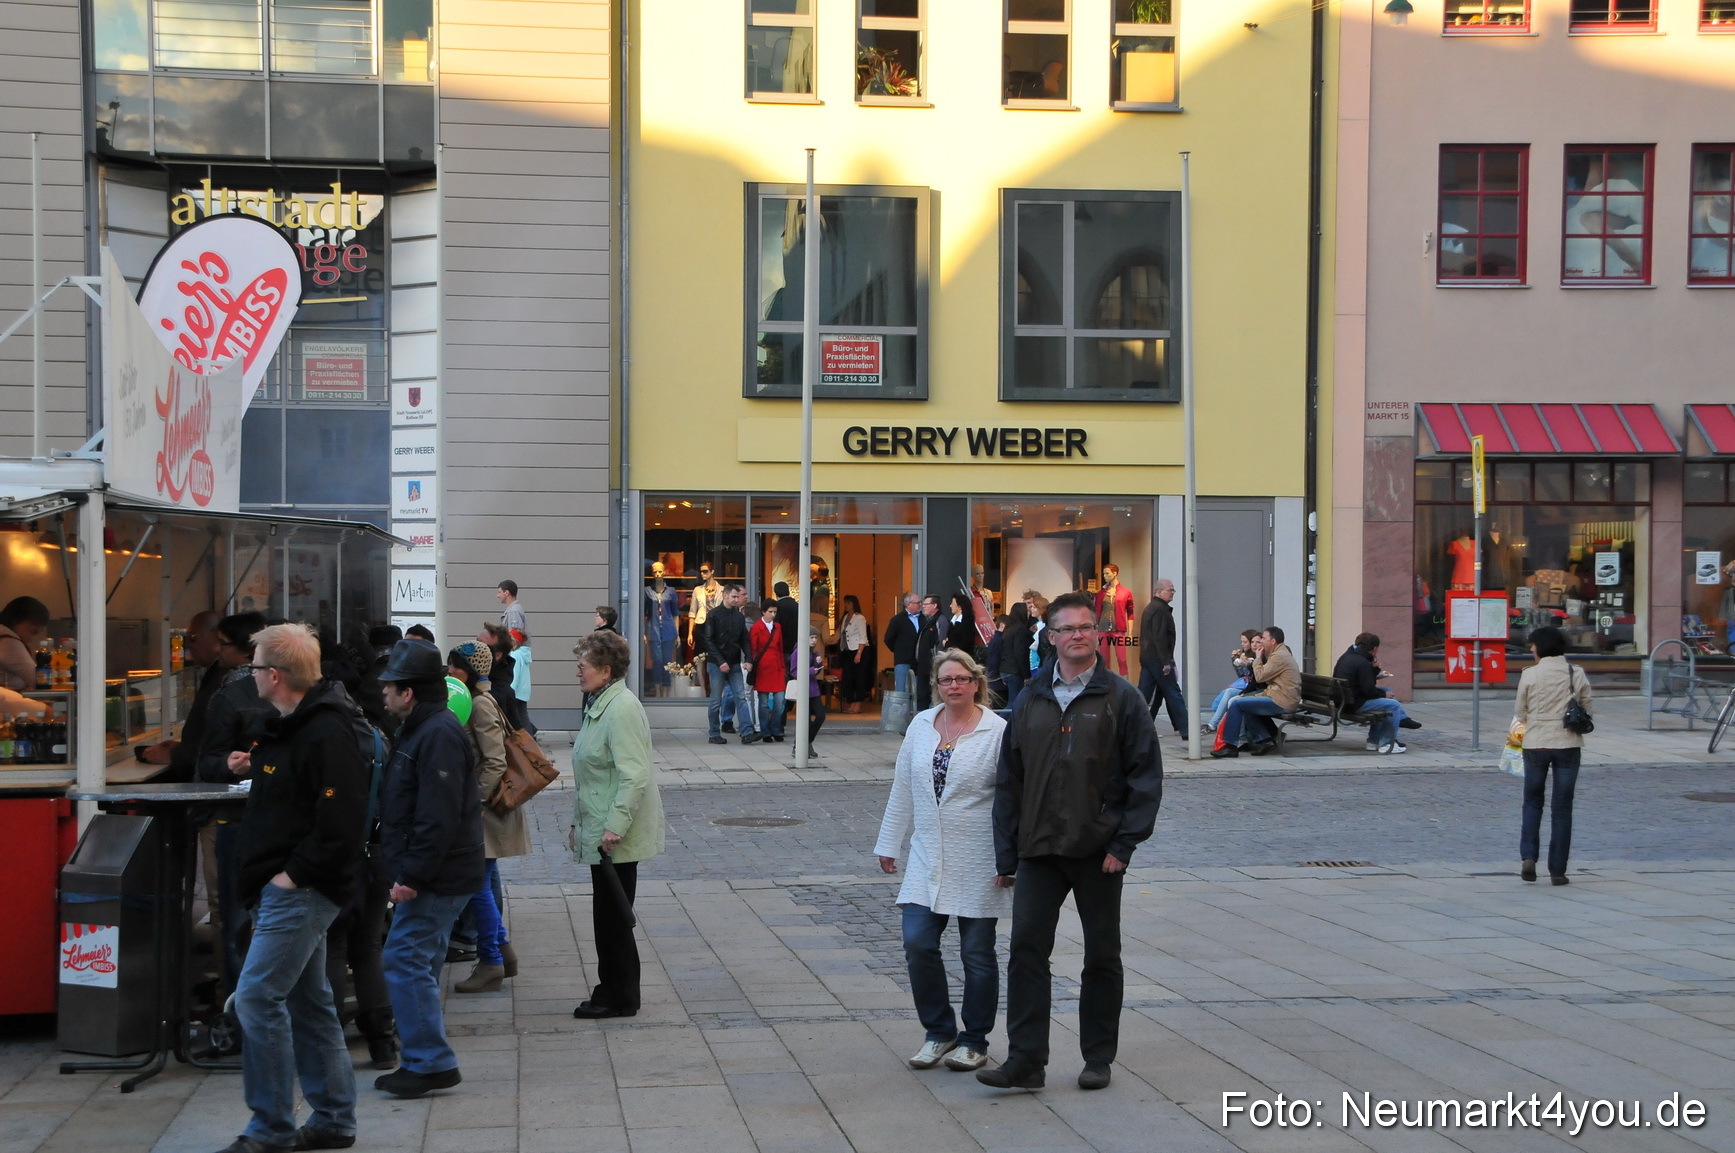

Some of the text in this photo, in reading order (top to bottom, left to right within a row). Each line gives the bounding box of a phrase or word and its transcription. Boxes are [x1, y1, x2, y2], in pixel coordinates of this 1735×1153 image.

[832, 344, 853, 352] Büro-
[826, 353, 875, 361] Praxisflächen
[310, 370, 360, 378] Praxisflächen
[1367, 401, 1409, 409] UNTERER
[1367, 412, 1409, 420] MARKT 15
[842, 425, 1089, 457] GERRY WEBER
[394, 446, 435, 455] GERRY WEBER
[192, 458, 212, 498] IMBISS
[395, 579, 434, 602] Martini
[1106, 636, 1139, 647] WEBE
[63, 943, 112, 972] Lehmeier's
[92, 962, 113, 972] IMBISS
